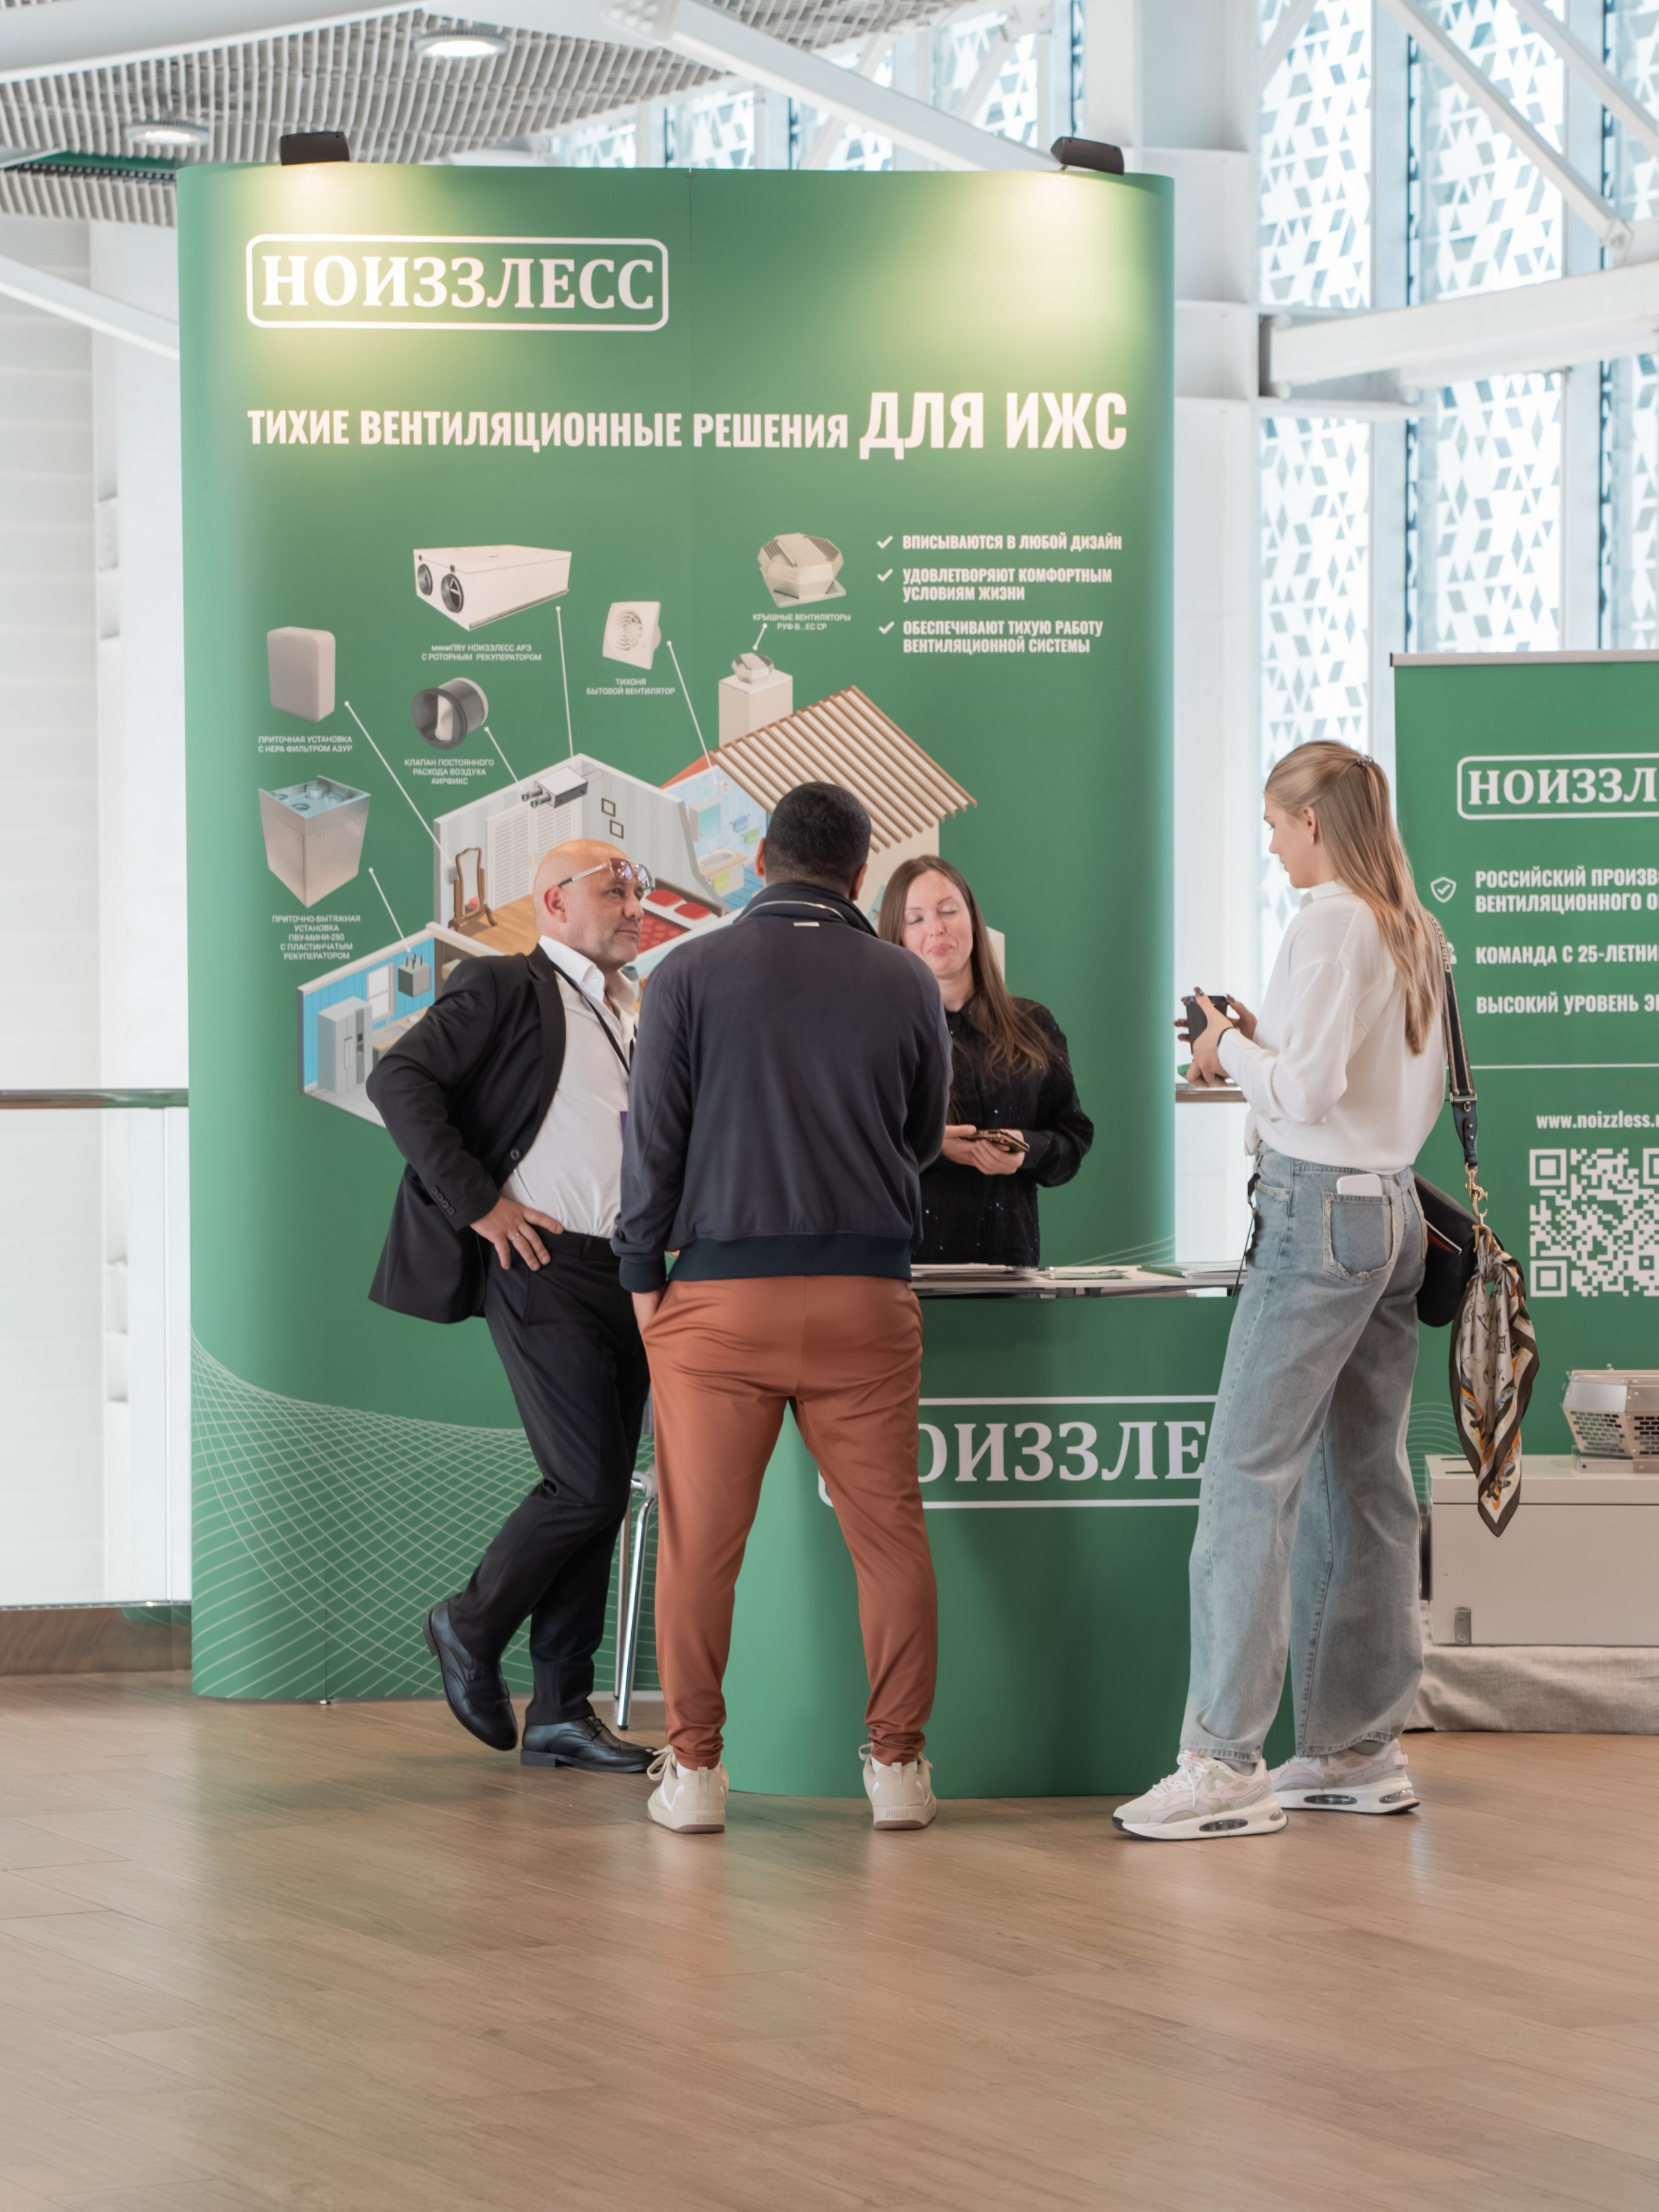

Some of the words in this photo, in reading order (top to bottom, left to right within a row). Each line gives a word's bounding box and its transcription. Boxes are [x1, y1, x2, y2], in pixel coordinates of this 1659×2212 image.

[262, 255, 654, 310] НОИЗЗЛЕСС
[248, 409, 349, 444] ТИХИЕ
[359, 409, 682, 452] ВЕНТИЛЯЦИОННЫЕ
[694, 413, 848, 448] РЕШЕНИЯ
[859, 391, 984, 459] ДЛЯ
[1006, 392, 1128, 450] ИЖС
[903, 535, 1003, 549] ВПИСЫВАЮТСЯ
[1007, 535, 1015, 549] В
[1019, 532, 1067, 549] ЛЮБОЙ
[1070, 533, 1122, 551] ДИЗАЙН
[903, 568, 1015, 585] УДОВЛЕТВОРЯЮТ
[1019, 568, 1111, 582] КОМФОРТНЫМ
[903, 586, 975, 603] УСЛОВИЯМ
[979, 586, 1025, 600] ЖИЗНИ
[903, 621, 1004, 634] ОБЕСПЕЧИВАЮТ
[1008, 620, 1052, 636] ТИХУЮ
[1056, 621, 1103, 637] РАБОТУ
[903, 636, 1025, 655] ВЕНТИЛЯЦИОННОЙ
[1029, 638, 1089, 652] СИСТЕМЫ
[1476, 866, 1586, 888] РОССИЙСКИЙ
[1592, 868, 1659, 886] ПРОИЗВ
[1476, 893, 1642, 914] ВЕНТИЛЯЦИОННОГО
[1476, 946, 1557, 966] КОМАНДА
[1562, 945, 1573, 963] С
[1578, 945, 1659, 962] 25-ЛЕТНИ
[1477, 992, 1558, 1013] ВЫСОКИЙ
[1564, 995, 1639, 1015] УРОВЕНЬ
[1644, 994, 1659, 1011] Э
